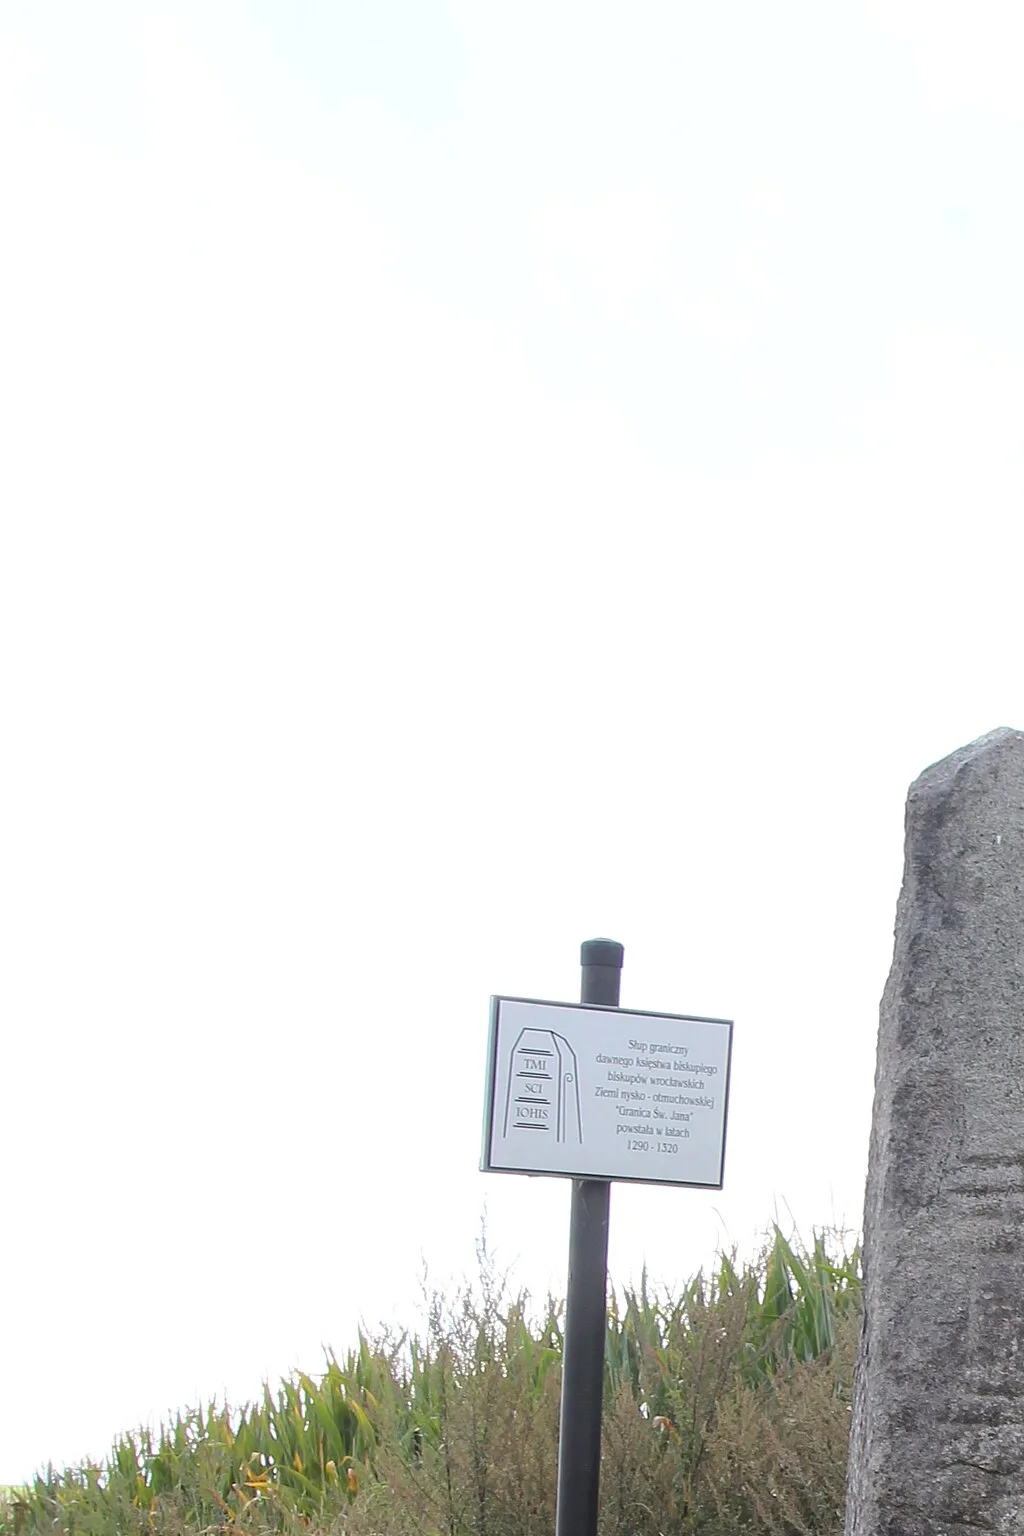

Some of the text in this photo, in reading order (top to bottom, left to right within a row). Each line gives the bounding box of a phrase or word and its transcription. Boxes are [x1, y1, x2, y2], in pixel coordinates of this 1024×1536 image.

[628, 1040, 688, 1057] Słup graniczny
[524, 1059, 546, 1071] TMI
[596, 1054, 717, 1076] dawnego księstwa biskupiego
[608, 1072, 704, 1089] biskupów wrocławskich
[525, 1083, 542, 1094] SCI
[595, 1087, 619, 1098] Ziemi
[621, 1090, 645, 1102] nysko
[653, 1093, 715, 1109] otmuchowskiej
[516, 1107, 549, 1119] IOHIS
[616, 1106, 693, 1121] "Granica Św. Jana"
[617, 1124, 654, 1135] powstała
[627, 1140, 649, 1151] 1290
